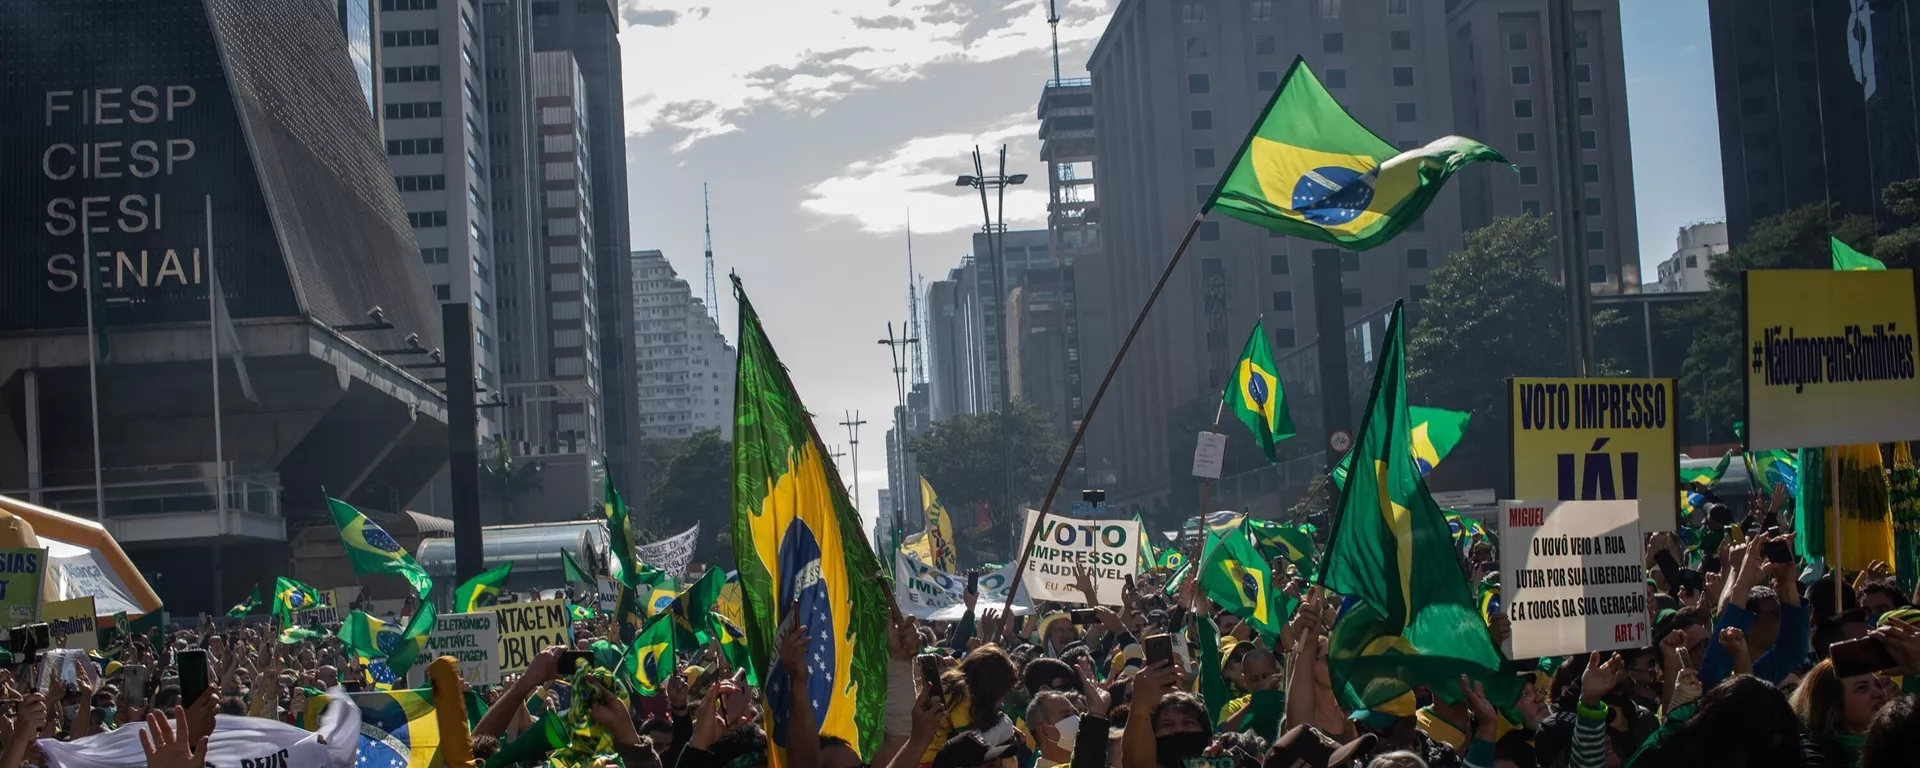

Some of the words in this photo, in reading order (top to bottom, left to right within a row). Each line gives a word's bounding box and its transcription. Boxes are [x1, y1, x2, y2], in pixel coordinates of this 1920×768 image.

[45, 85, 197, 127] FIESP
[42, 138, 197, 181] CIESP
[45, 193, 161, 236] SESI
[47, 247, 201, 292] SENAI
[1752, 321, 1915, 394] #NãoIgnorem58milhões
[1519, 383, 1570, 431] VOTO
[1574, 383, 1666, 430] IMPRESSO
[1509, 507, 1545, 528] MIGUEL
[1038, 520, 1127, 548] VOTO
[1533, 538, 1540, 556] O
[1542, 534, 1568, 556] VOVÔ
[1571, 537, 1591, 556] VEIO
[1594, 538, 1601, 555] A
[1605, 536, 1626, 554] RUA
[1029, 560, 1036, 571] E
[1030, 545, 1128, 566] IMPRESSO
[1516, 569, 1545, 589] LUTAR
[1547, 568, 1567, 587] POR
[1567, 567, 1588, 586] SUA
[1590, 565, 1643, 585] LIBERDADE
[1511, 602, 1517, 621] E
[1518, 602, 1526, 621] A
[1527, 600, 1561, 620] TODOS
[1562, 599, 1577, 618] DA
[1578, 597, 1599, 616] SUA
[1600, 592, 1645, 618] GERAÇÃO
[437, 616, 490, 632] ELETRÔNICO
[1615, 624, 1634, 643] ART.
[425, 633, 479, 650] AUDITÁVEL
[359, 723, 410, 757] PROGRESSO
